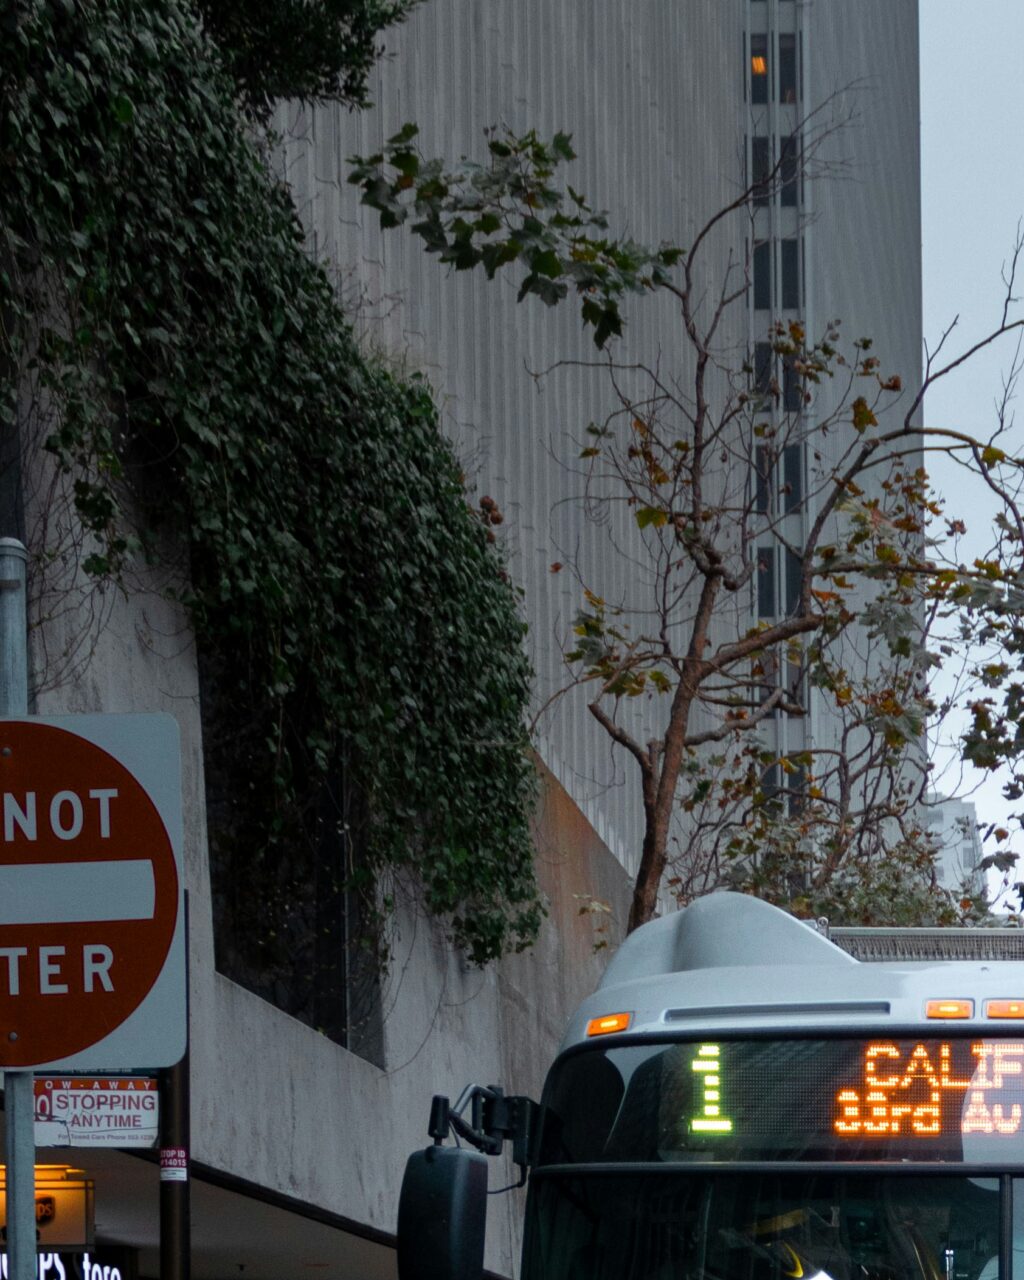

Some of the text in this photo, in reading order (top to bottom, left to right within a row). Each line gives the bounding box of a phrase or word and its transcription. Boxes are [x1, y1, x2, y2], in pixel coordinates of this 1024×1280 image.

[3, 788, 120, 842] NOT
[691, 1044, 733, 1132] 1
[34, 1094, 156, 1122] O STOPPING
[70, 1113, 143, 1128] ANYTIME
[961, 1090, 1022, 1134] Av
[177, 1150, 186, 1158] ID
